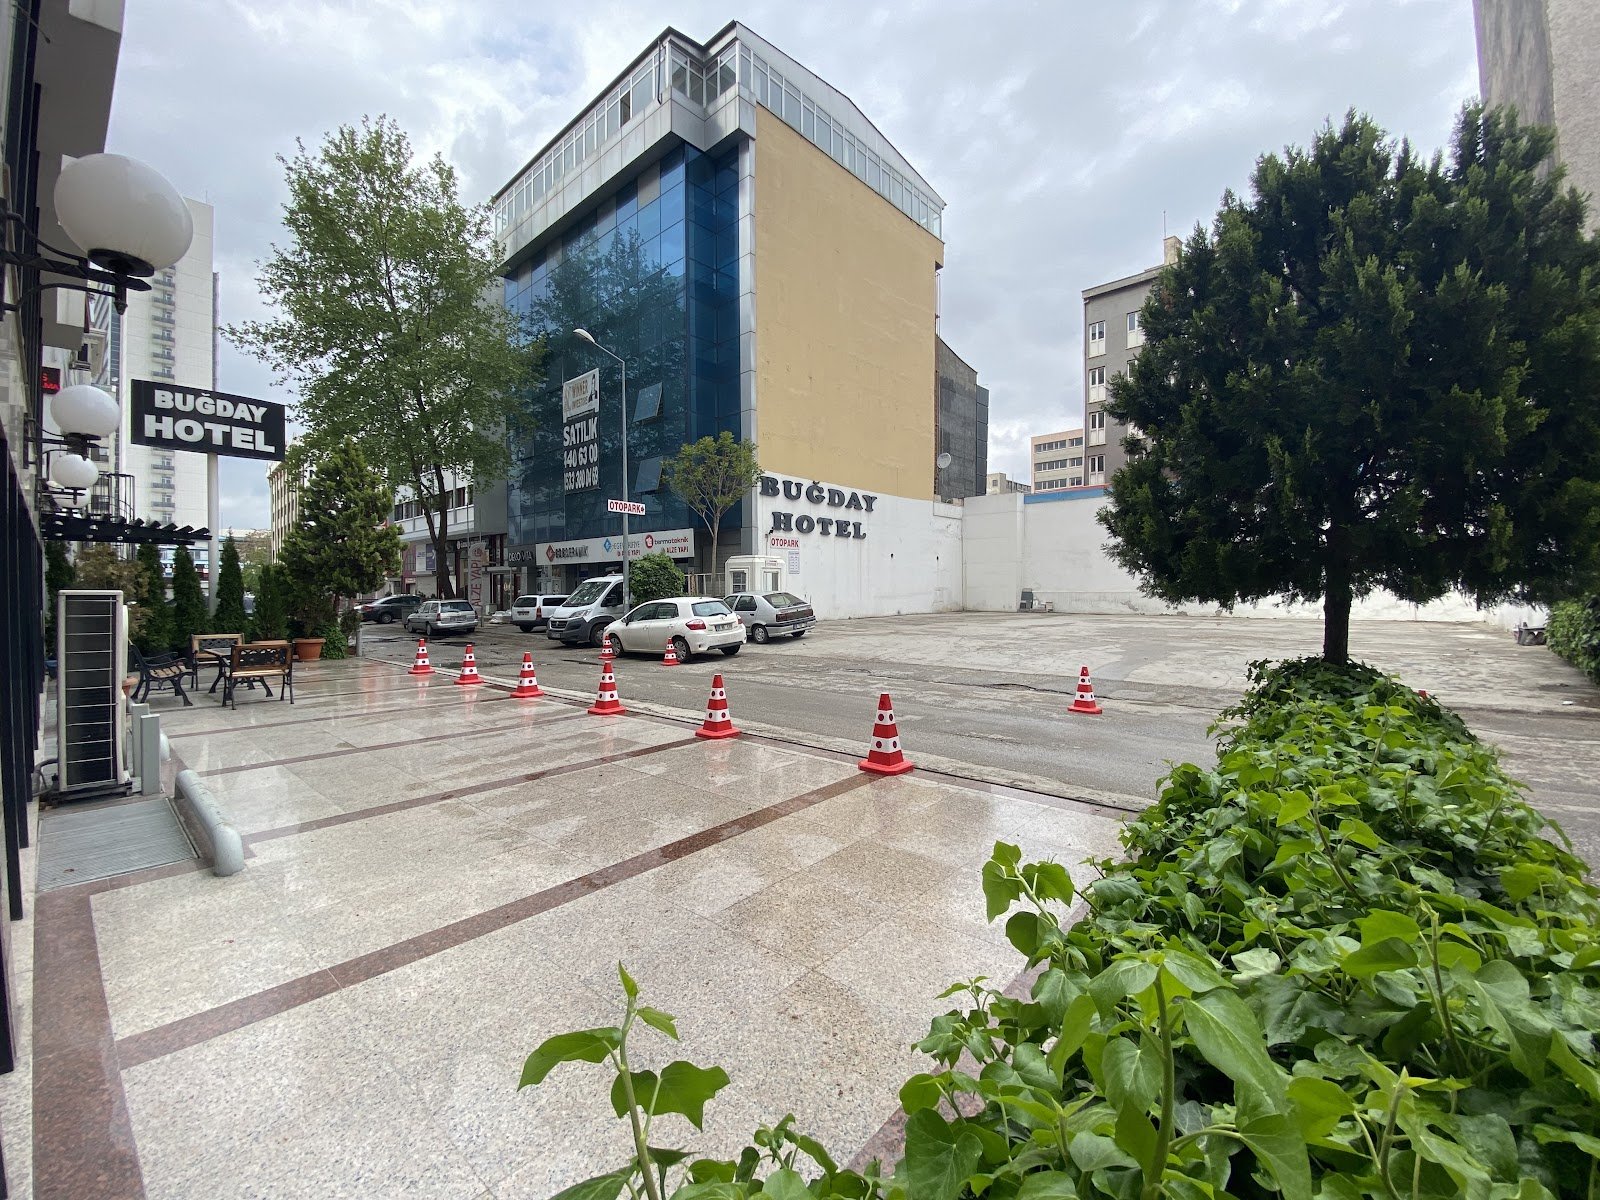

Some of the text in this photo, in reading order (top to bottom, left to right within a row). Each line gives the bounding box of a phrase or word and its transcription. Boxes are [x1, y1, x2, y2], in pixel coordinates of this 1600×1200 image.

[154, 389, 268, 424] BUĞDAY
[144, 414, 276, 453] HOTEL
[563, 416, 598, 447] SATILIK
[610, 501, 641, 514] OTOPARK
[760, 475, 877, 512] BUĞDAY
[772, 512, 866, 539] HOTEL
[771, 537, 799, 548] OTOPARK
[471, 559, 482, 581] YAPI
